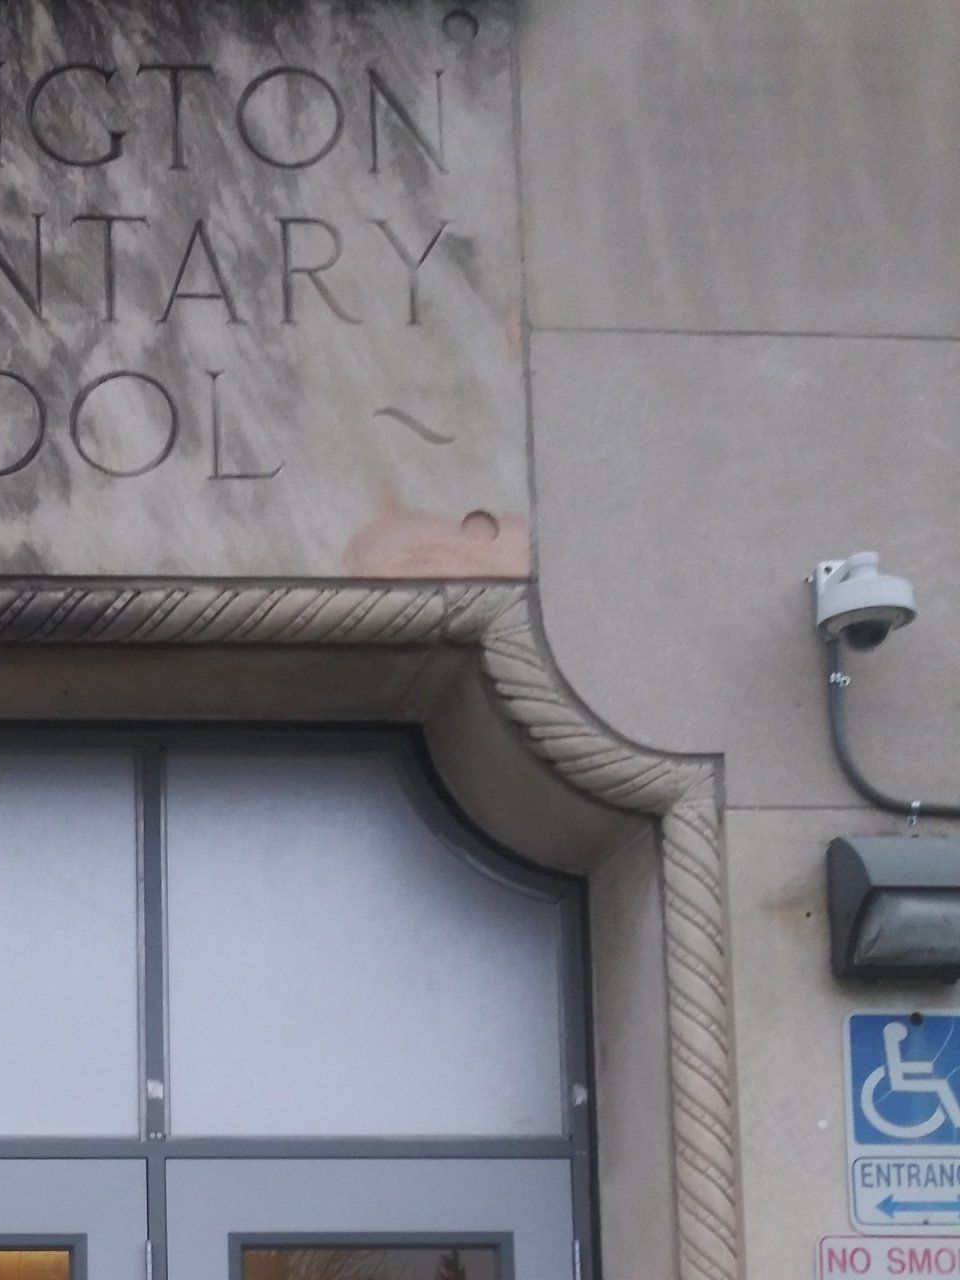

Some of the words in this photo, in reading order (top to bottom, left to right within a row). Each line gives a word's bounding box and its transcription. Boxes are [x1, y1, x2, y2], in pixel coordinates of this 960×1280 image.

[860, 1162, 960, 1188] ENTRAN
[827, 1246, 871, 1274] NO
[887, 1246, 960, 1275] SMO
